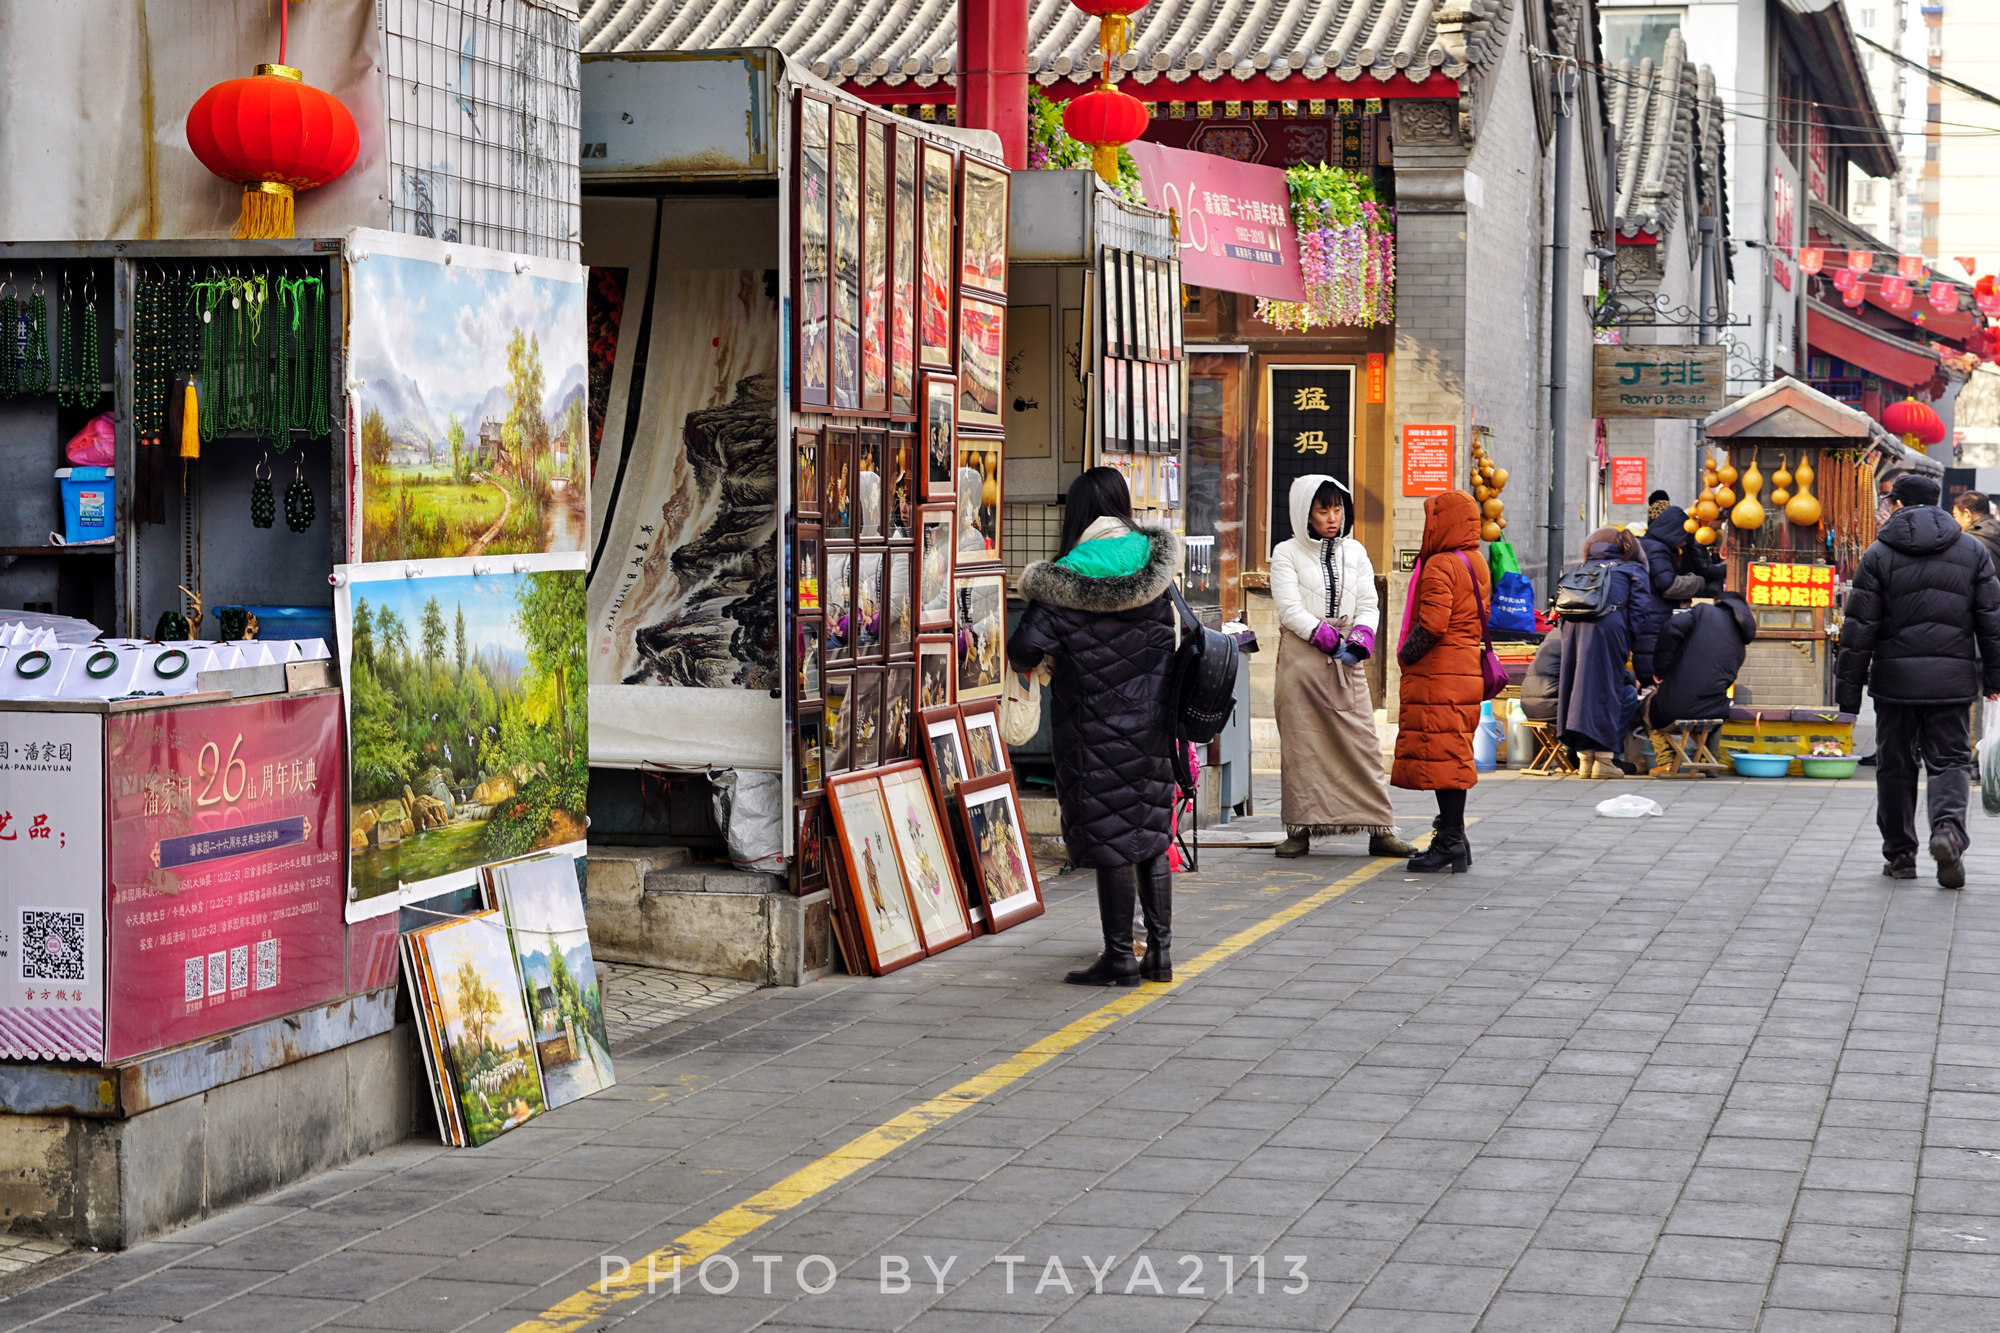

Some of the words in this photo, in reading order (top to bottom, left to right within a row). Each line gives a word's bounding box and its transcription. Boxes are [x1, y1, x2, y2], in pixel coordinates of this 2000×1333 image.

[1202, 191, 1287, 227] 潘家园二十六周年庆典
[1615, 360, 1704, 386] 丁排
[1293, 387, 1331, 455] 猛犸
[1752, 564, 1831, 584] 专业穿串
[1751, 585, 1830, 607] 各种配饰
[197, 733, 247, 806] 26
[261, 757, 318, 800] 周年庆典
[189, 829, 279, 857] 潘家园二十六周年庆典活动安排
[25, 987, 82, 1001] 官方微信
